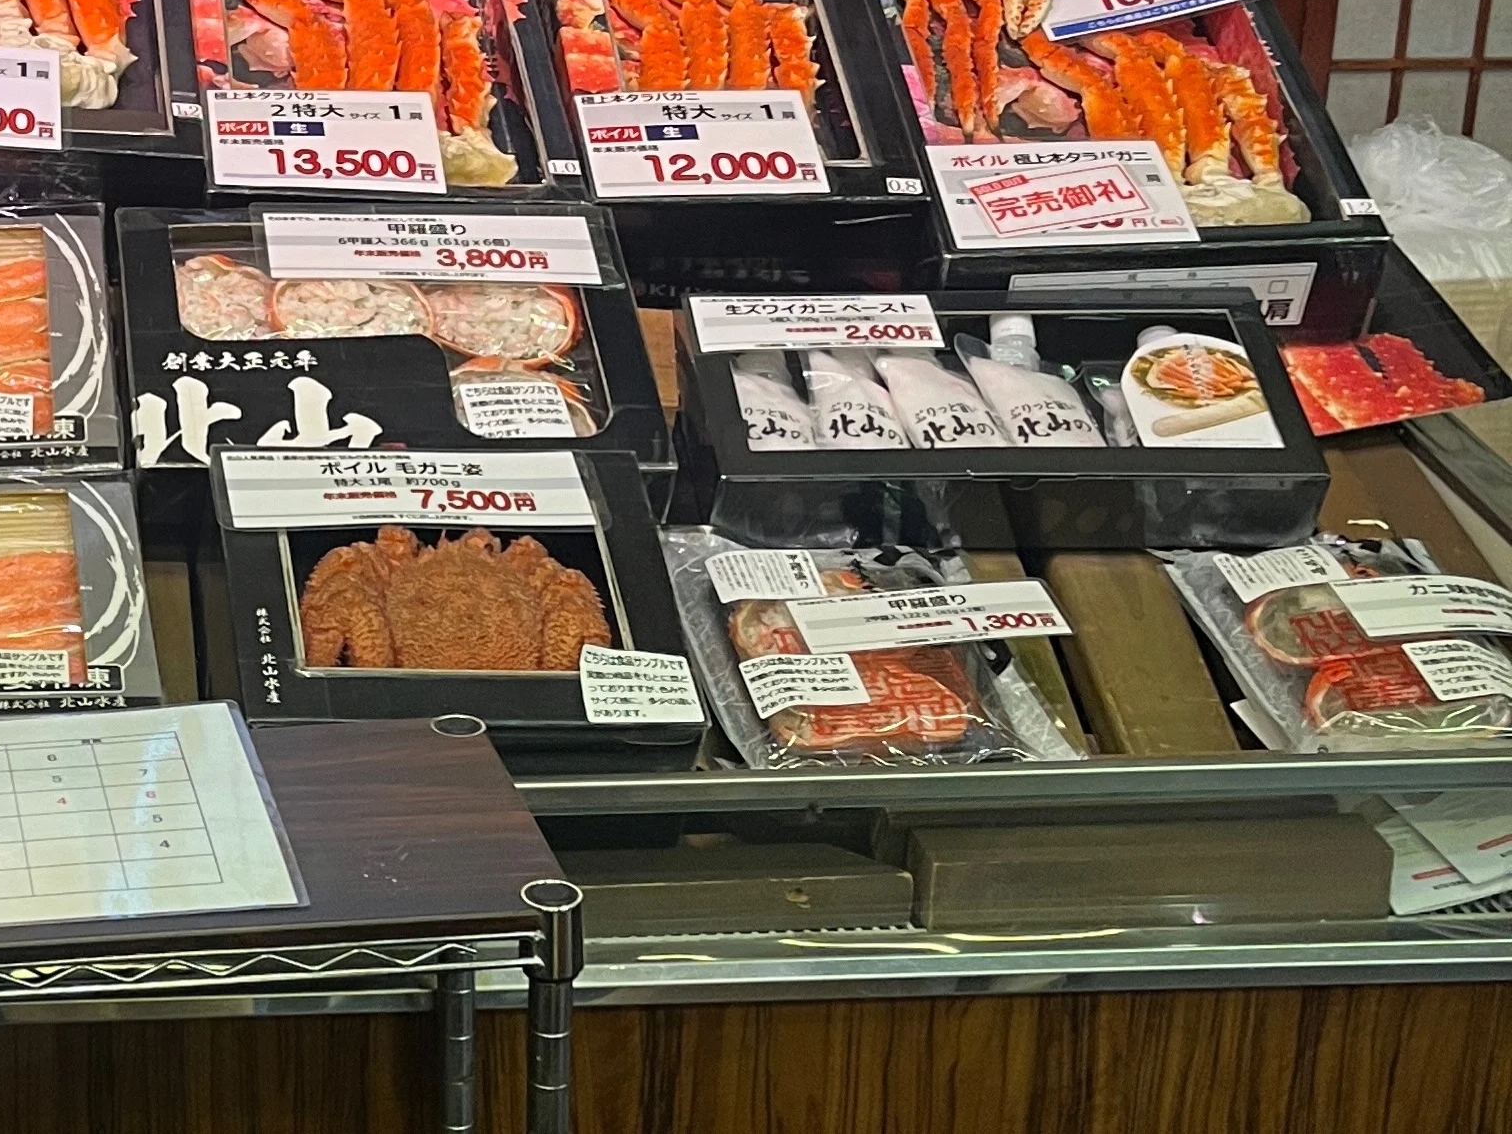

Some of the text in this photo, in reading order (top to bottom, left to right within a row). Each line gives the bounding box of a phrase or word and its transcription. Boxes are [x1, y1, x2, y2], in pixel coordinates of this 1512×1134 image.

[17, 62, 29, 77] 1
[388, 105, 402, 119] 1
[662, 105, 716, 120] 特大
[760, 105, 773, 120] 1
[219, 122, 309, 134] ボイル 生
[590, 126, 682, 141] ボイル 生
[951, 154, 1009, 168] ボイル
[888, 179, 918, 192] 0.8
[986, 178, 1136, 222] 完売御礼
[387, 223, 467, 235] 甲羅盛り
[161, 349, 319, 372] 創業大正元年
[131, 376, 383, 468] 北山
[1018, 412, 1092, 443] 北山の
[829, 414, 903, 445] 北山の
[923, 415, 994, 448] 北山の
[320, 461, 387, 475] ボイル
[334, 478, 363, 488] 特大
[889, 594, 966, 610] 甲羅盛り
[56, 797, 67, 805] 4
[152, 814, 163, 823] 5
[159, 840, 170, 849] 4
